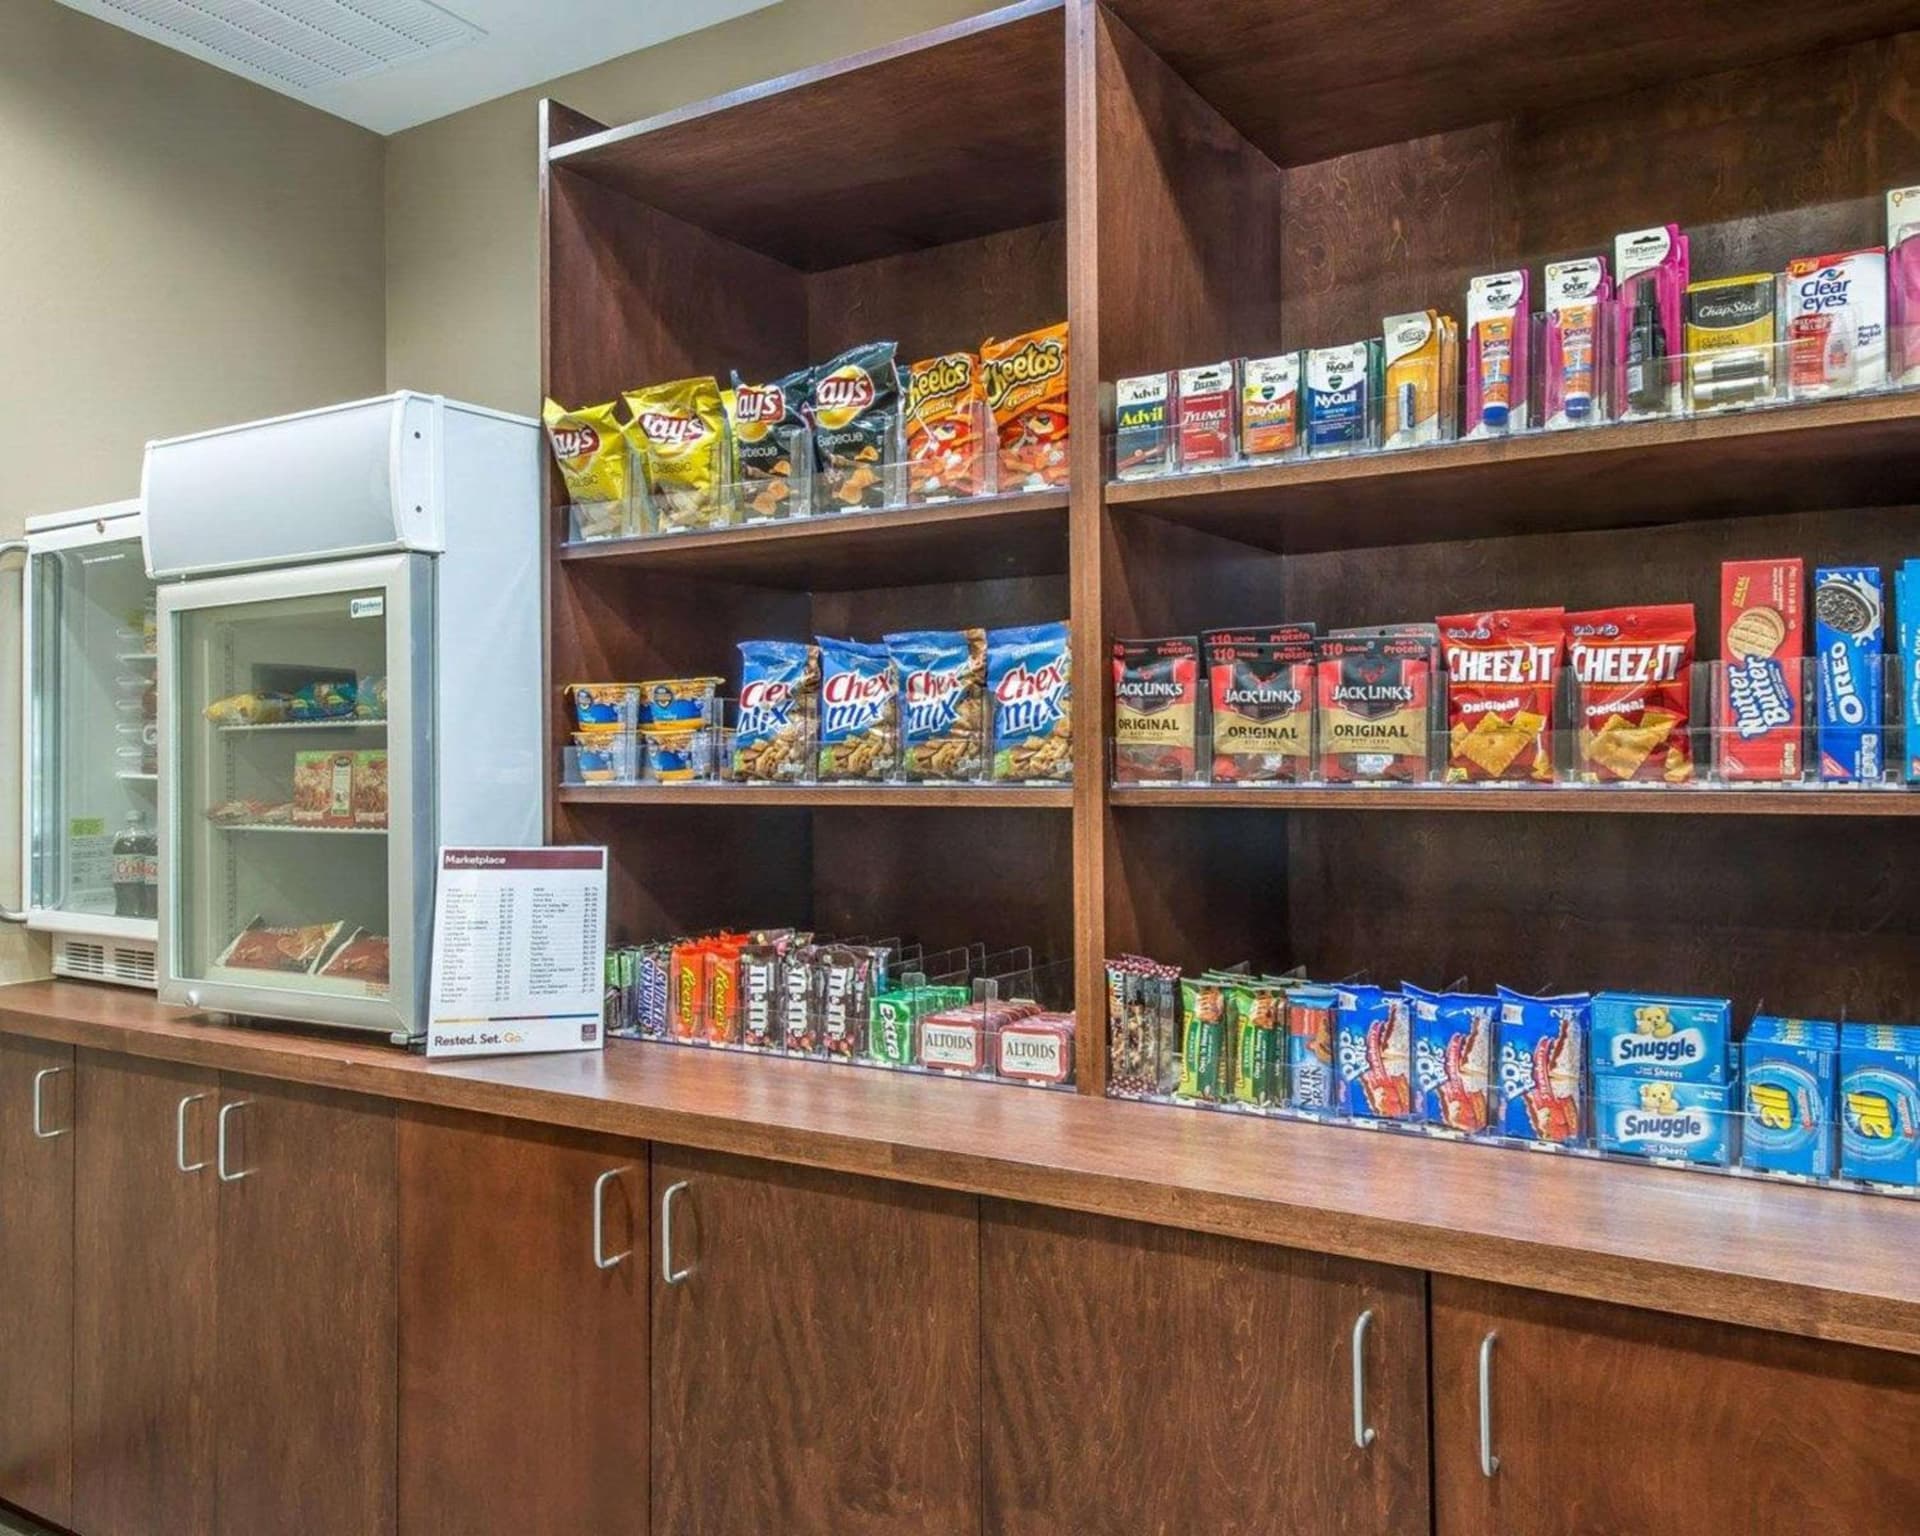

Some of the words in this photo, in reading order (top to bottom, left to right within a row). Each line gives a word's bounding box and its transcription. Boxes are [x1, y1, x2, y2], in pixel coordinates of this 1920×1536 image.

[1801, 280, 1851, 297] Clear
[1699, 300, 1760, 317] ChapStick
[1803, 293, 1847, 312] eyes
[818, 379, 868, 409] ay's
[906, 359, 967, 416] heetos
[1131, 387, 1160, 400] Advil
[739, 393, 780, 422] ay's
[1314, 390, 1357, 408] NyQuil
[1120, 406, 1164, 426] Advil
[1184, 409, 1226, 424] TYLENOL
[1247, 400, 1291, 417] DayQuil
[551, 428, 594, 458] ay's
[1213, 648, 1235, 660] 110
[1321, 643, 1343, 655] 110
[1384, 644, 1425, 655] Protein
[825, 671, 890, 703] Chex
[997, 663, 1064, 701] Chex
[1116, 682, 1145, 696] JACK
[1747, 655, 1791, 727] Butter
[1831, 641, 1864, 724] OREO
[1225, 689, 1257, 704] JACK
[1332, 685, 1367, 700] JACK
[1728, 666, 1767, 738] Nutter
[1118, 718, 1179, 731] ORIGINAL
[1228, 726, 1298, 740] ORIGINAL
[1334, 724, 1408, 738] ORIGINAL
[445, 855, 506, 866] Marketplace
[1113, 970, 1124, 1005] KIND
[434, 1034, 477, 1046] Rested.
[480, 1033, 501, 1044] Set.
[926, 1032, 973, 1051] ALTOIDS
[1005, 1041, 1056, 1060] ALTOIDS
[1619, 1037, 1697, 1061] Snuggle
[1653, 1067, 1683, 1079] Sheets
[1750, 1084, 1792, 1130] all
[1847, 1092, 1893, 1140] all
[1624, 1114, 1702, 1138] Snuggle
